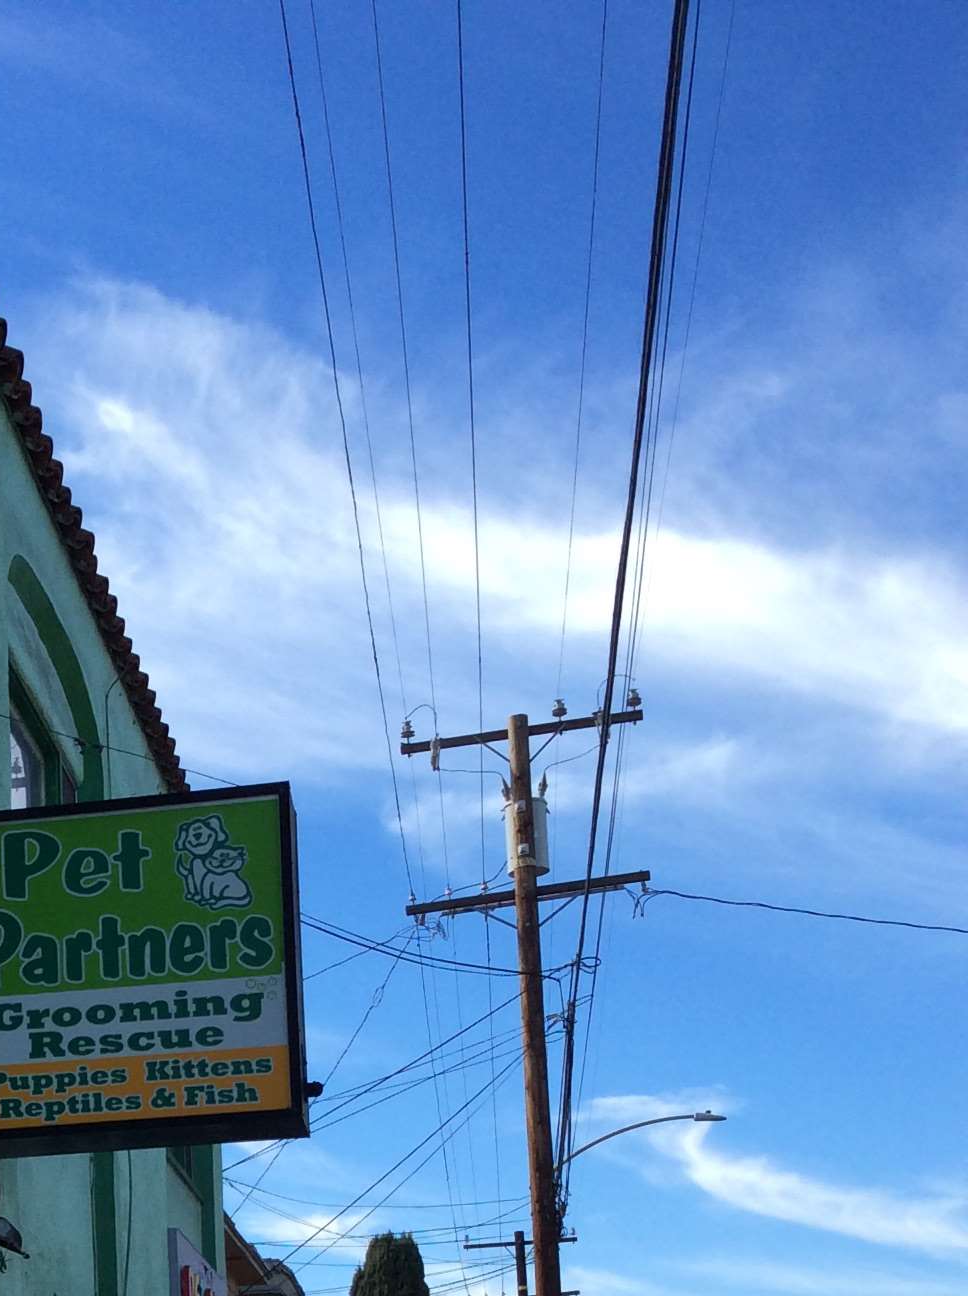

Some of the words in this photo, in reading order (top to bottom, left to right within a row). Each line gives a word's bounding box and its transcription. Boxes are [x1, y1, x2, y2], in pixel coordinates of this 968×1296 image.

[1, 829, 152, 900] Pet
[28, 1025, 224, 1058] Rescue
[144, 1057, 272, 1081] Kittens
[0, 1092, 141, 1121] Reptiles
[151, 1088, 176, 1108] &
[184, 1082, 258, 1106] Fish
